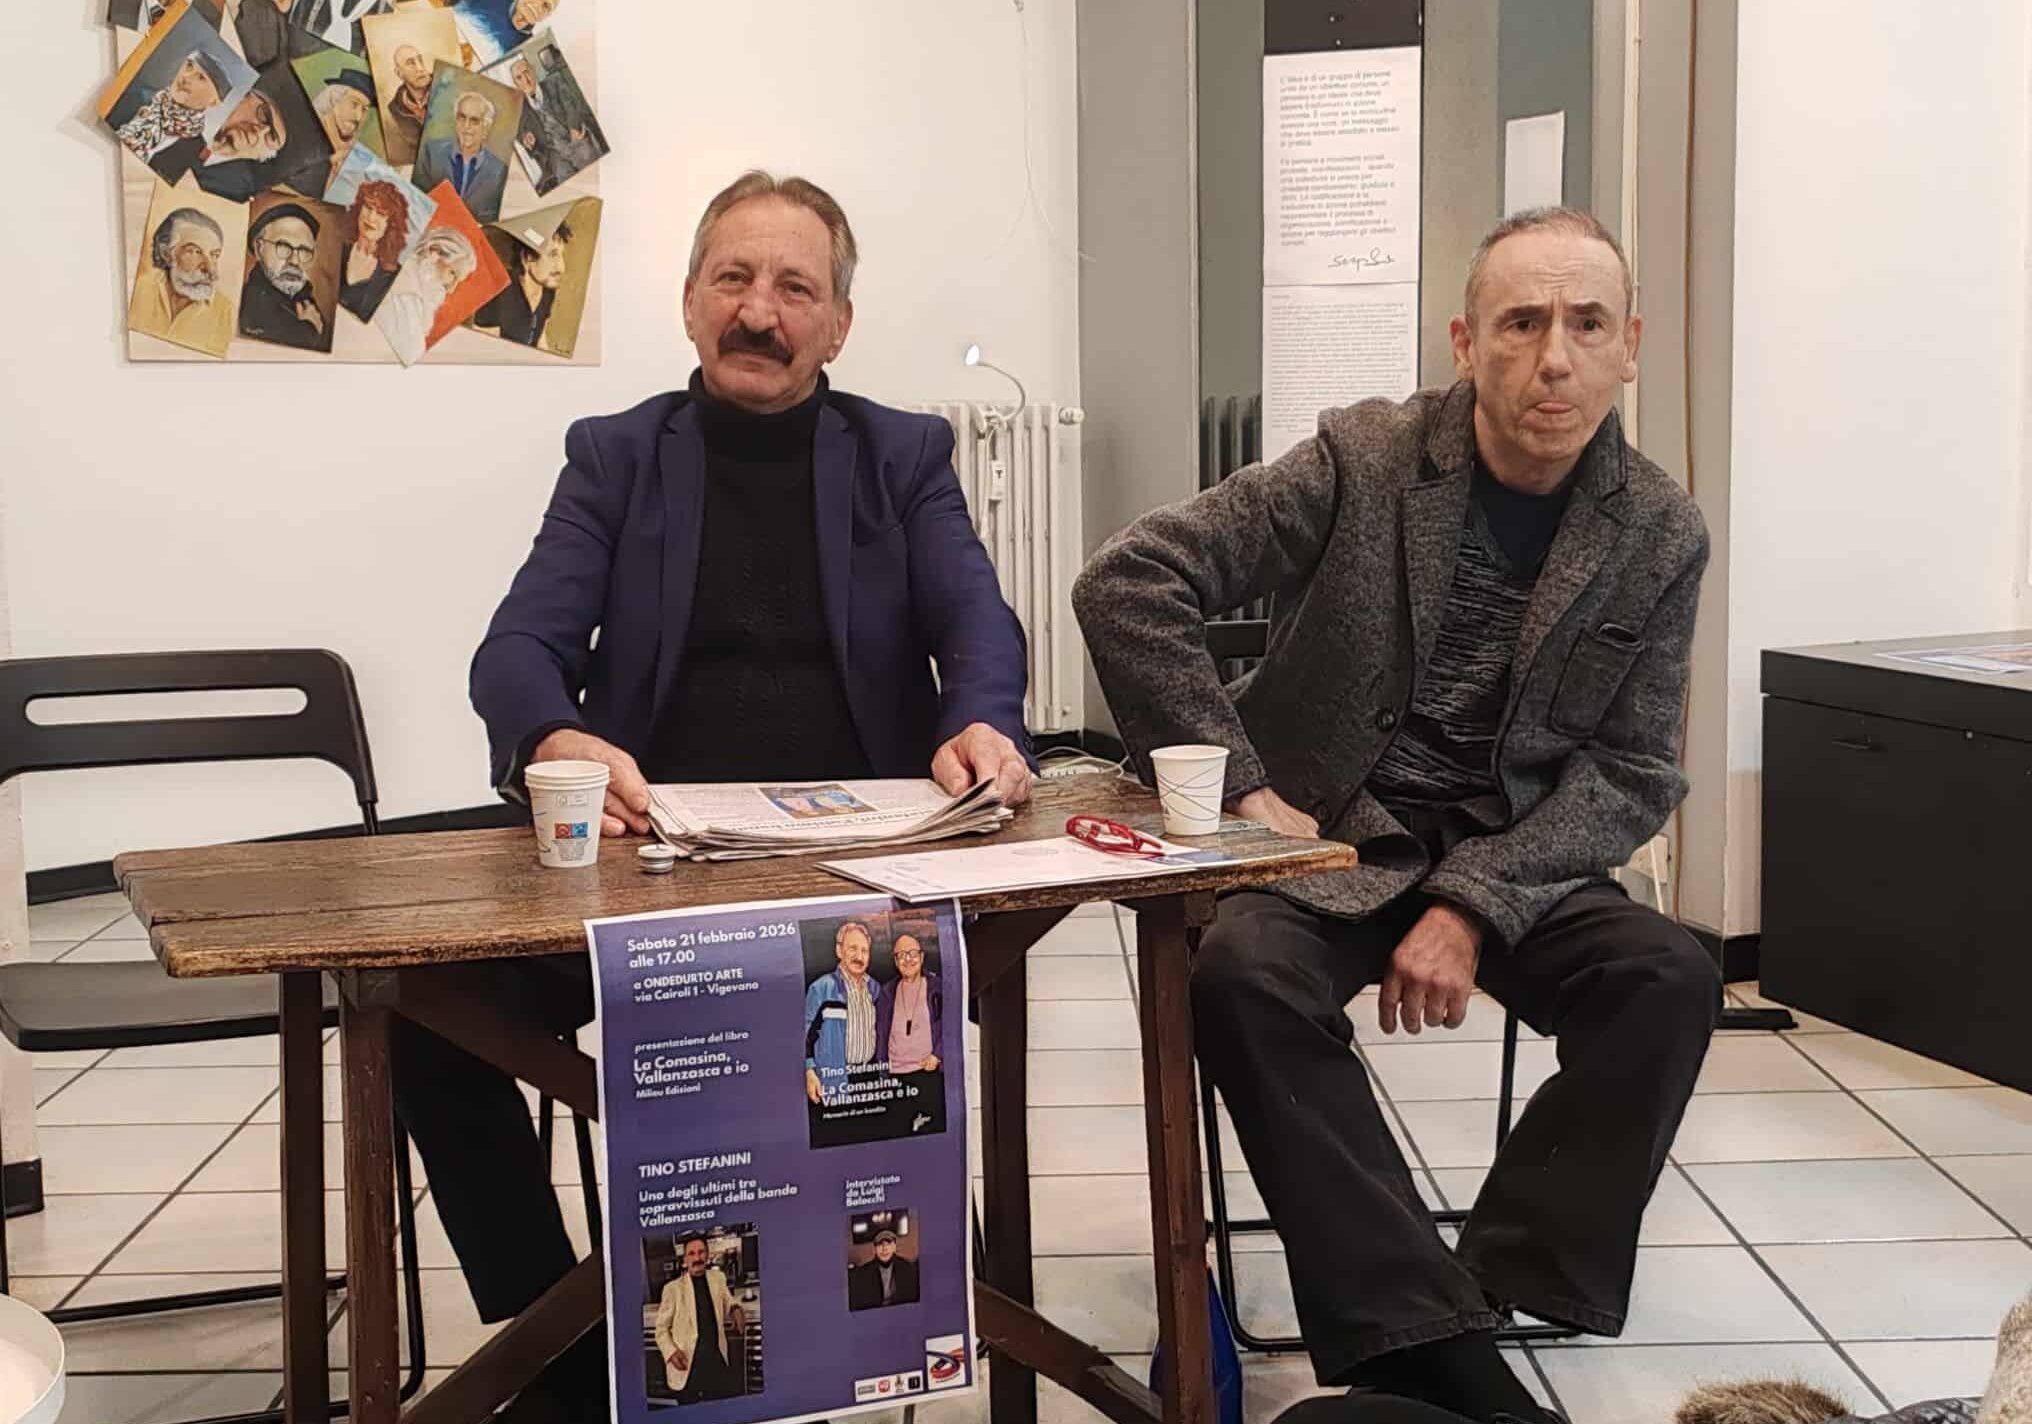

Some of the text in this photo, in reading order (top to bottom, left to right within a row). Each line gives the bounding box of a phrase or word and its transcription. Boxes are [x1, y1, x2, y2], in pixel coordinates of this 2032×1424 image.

[627, 922, 796, 952] Sabato 21 febbraio 2026
[629, 950, 695, 968] alle 17.00
[633, 968, 743, 990] a ONDEDURTO ARTE
[635, 990, 652, 1002] via
[654, 986, 691, 1000] Cairoli
[707, 981, 759, 996] Vigevano
[635, 1030, 749, 1054] presentazione del libro
[634, 1051, 731, 1072] La Comasina,
[634, 1060, 749, 1084] Vallanzasca e io
[821, 1067, 844, 1078] Tino
[821, 1077, 902, 1095] La Comasina,
[821, 1085, 918, 1107] Vallanzasca e io
[639, 1152, 751, 1178] TINO STEFANINI
[639, 1179, 757, 1202] Uno degli ultimi tre
[639, 1184, 797, 1216] sopravvissuti della banda
[639, 1209, 715, 1227] Vallanzasca
